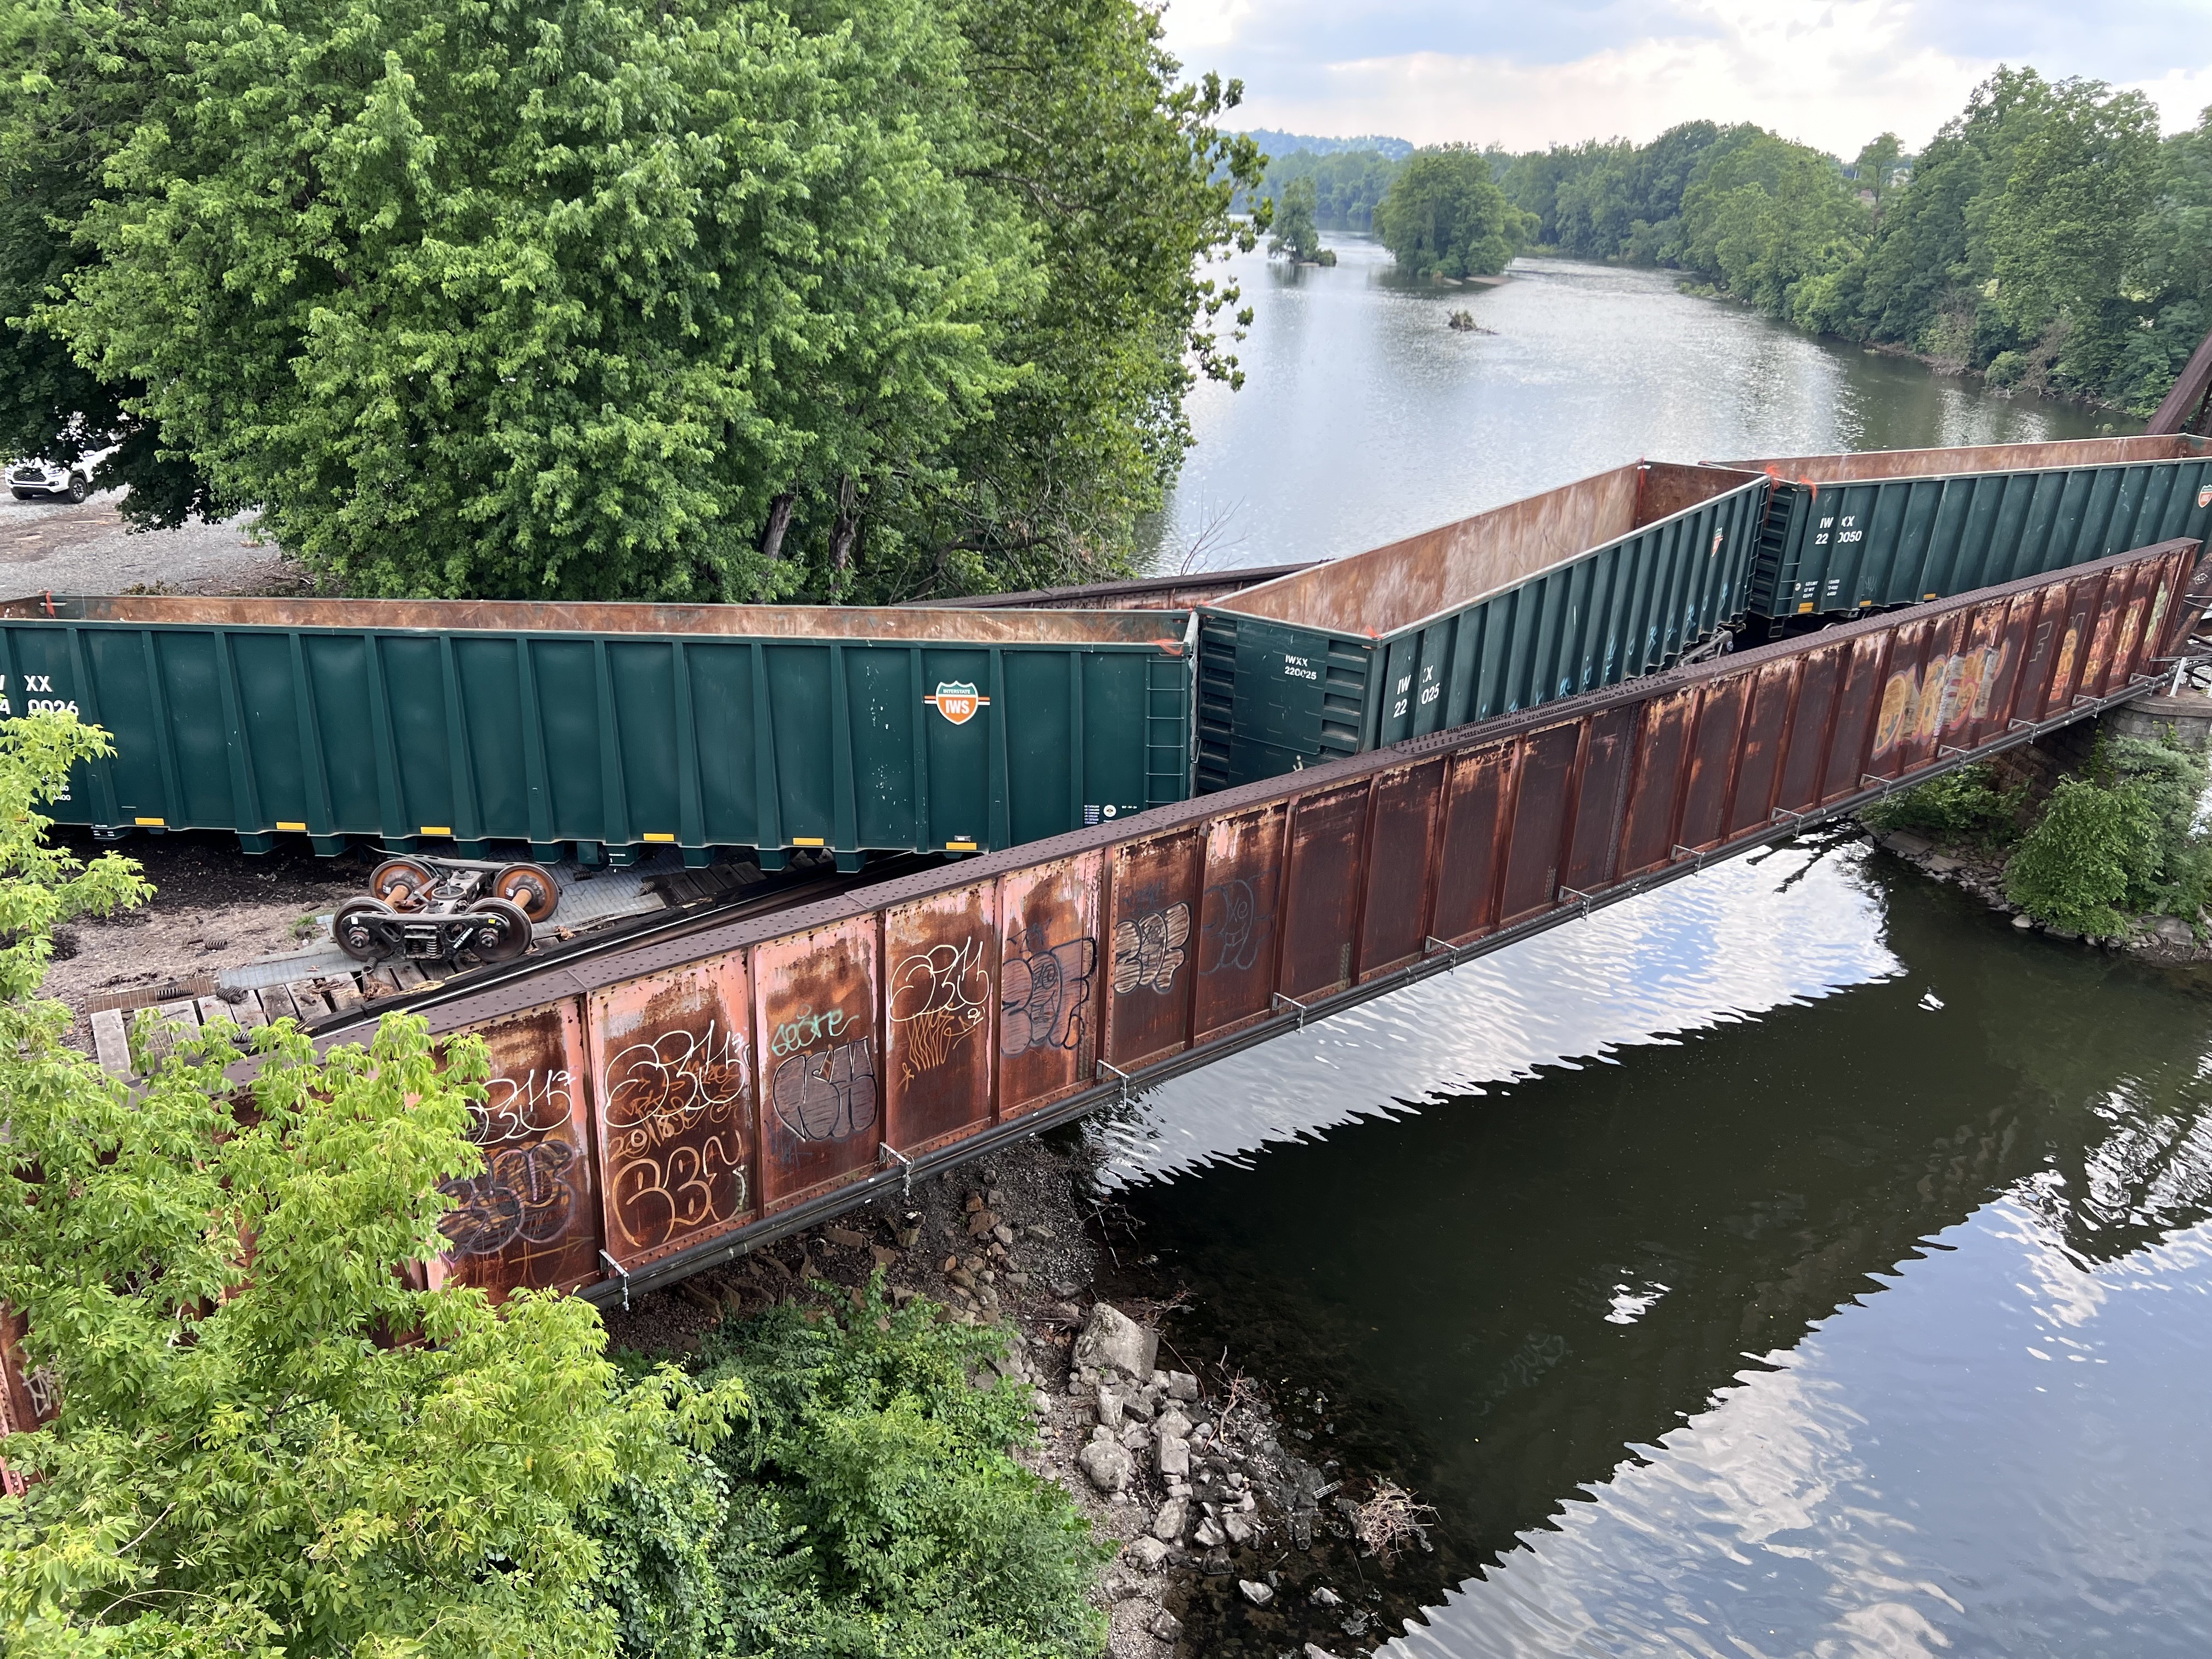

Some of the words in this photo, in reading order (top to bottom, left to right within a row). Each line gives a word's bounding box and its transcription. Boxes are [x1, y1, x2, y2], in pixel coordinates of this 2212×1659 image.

[1815, 533, 1829, 545] 22
[1285, 654, 1308, 667] IWXX
[1284, 665, 1317, 680] 220025
[24, 675, 53, 692] XX
[945, 699, 970, 714] IWS
[1393, 698, 1408, 718] 22
